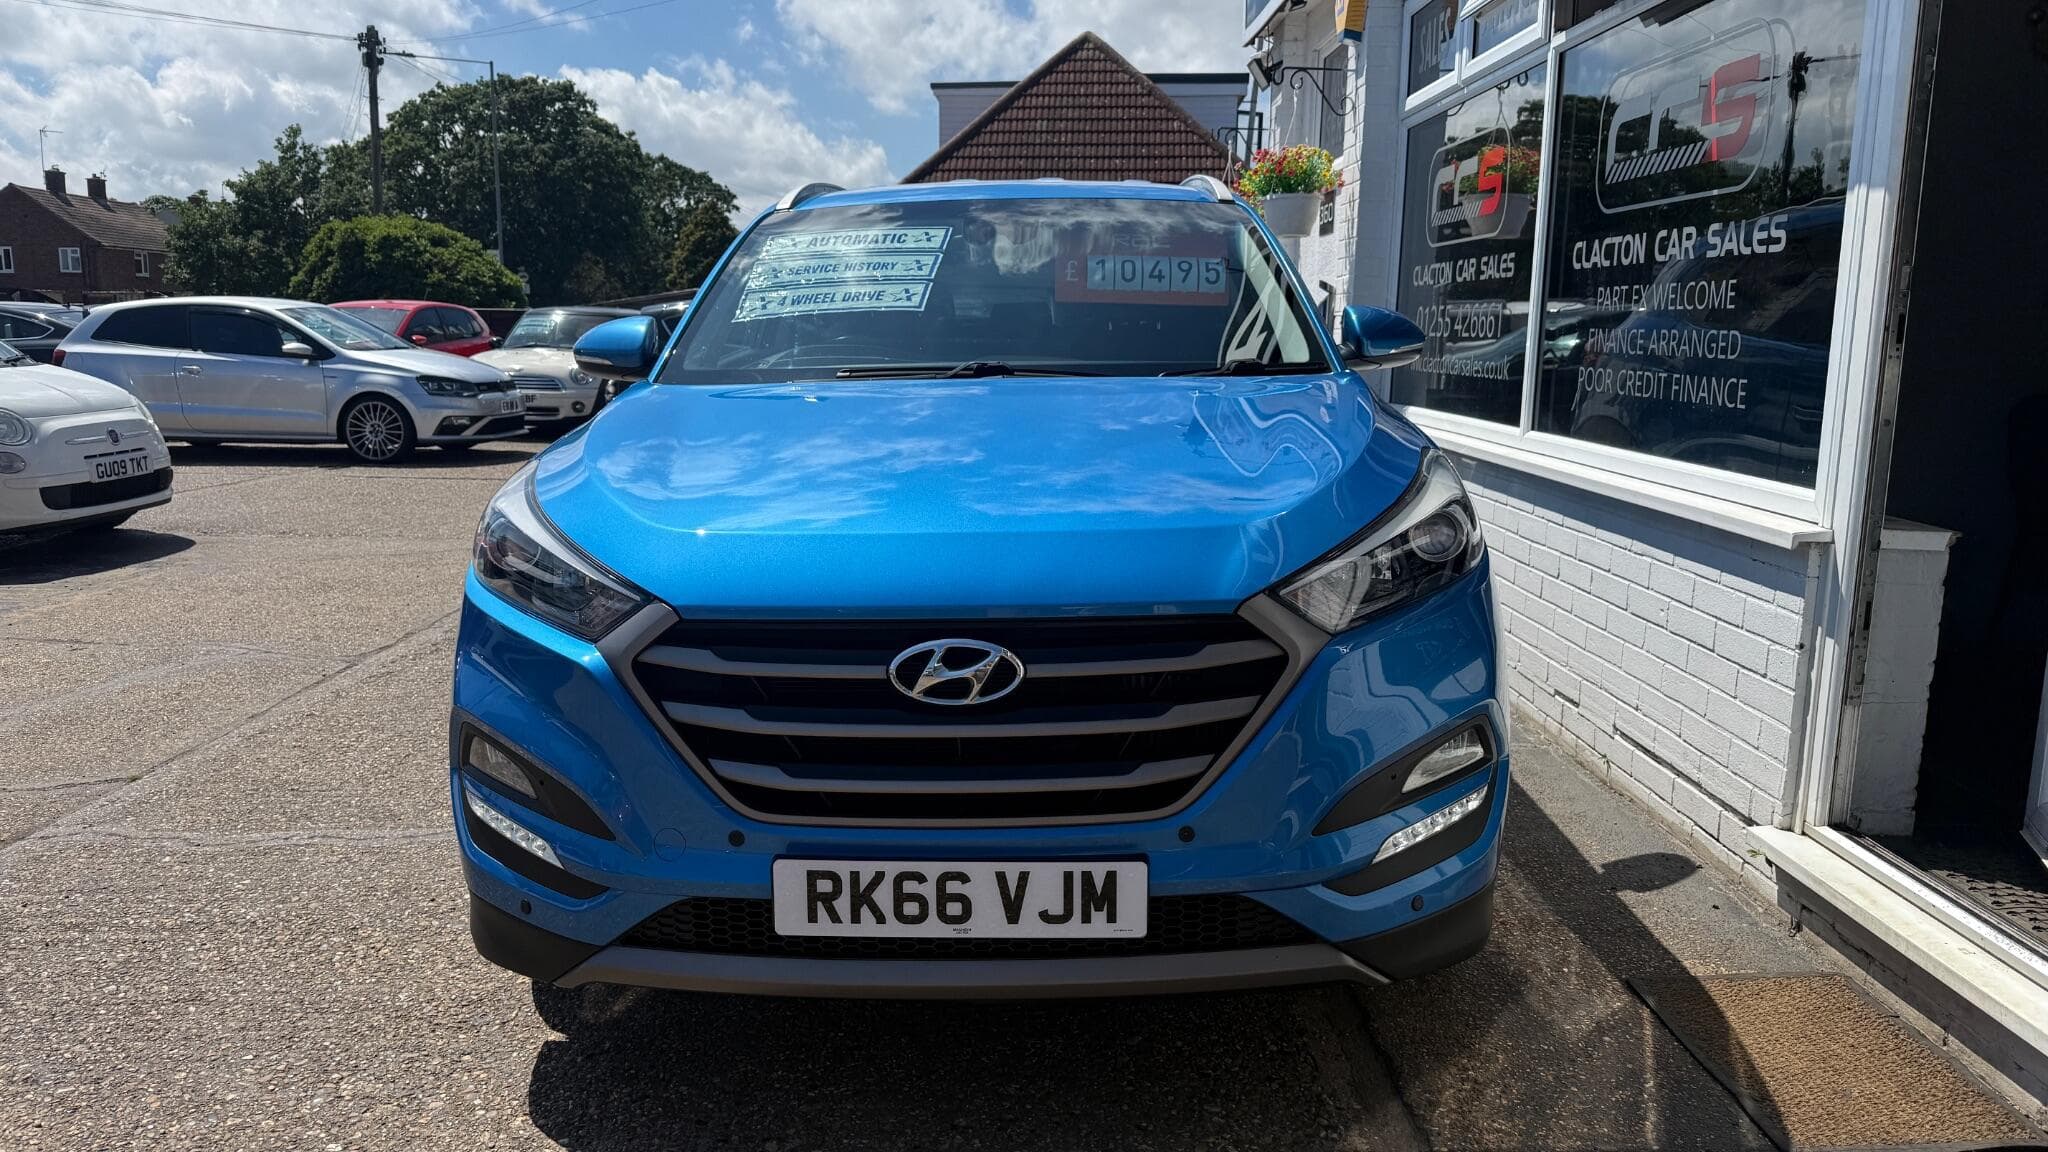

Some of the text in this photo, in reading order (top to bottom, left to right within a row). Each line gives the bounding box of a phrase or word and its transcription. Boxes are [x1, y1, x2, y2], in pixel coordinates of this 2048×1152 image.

[1418, 7, 1452, 75] SALES
[807, 233, 908, 248] AUTOMATIC
[1572, 214, 1788, 270] CLACTON CAR SALES
[788, 261, 899, 276] SERVICE HISTORY
[1095, 258, 1221, 285] 10495
[1413, 252, 1516, 287] CLACTON CAR SALES
[777, 290, 885, 308] 4 WHEEL DRIVE
[1596, 279, 1738, 311] PART EX WELCOME
[1588, 328, 1742, 360] FINANCE ARRANGED
[1578, 366, 1748, 409] POOR CREDIT FINANCE
[96, 455, 148, 479] GU09 TKT
[806, 870, 1118, 925] RK66 VJM
